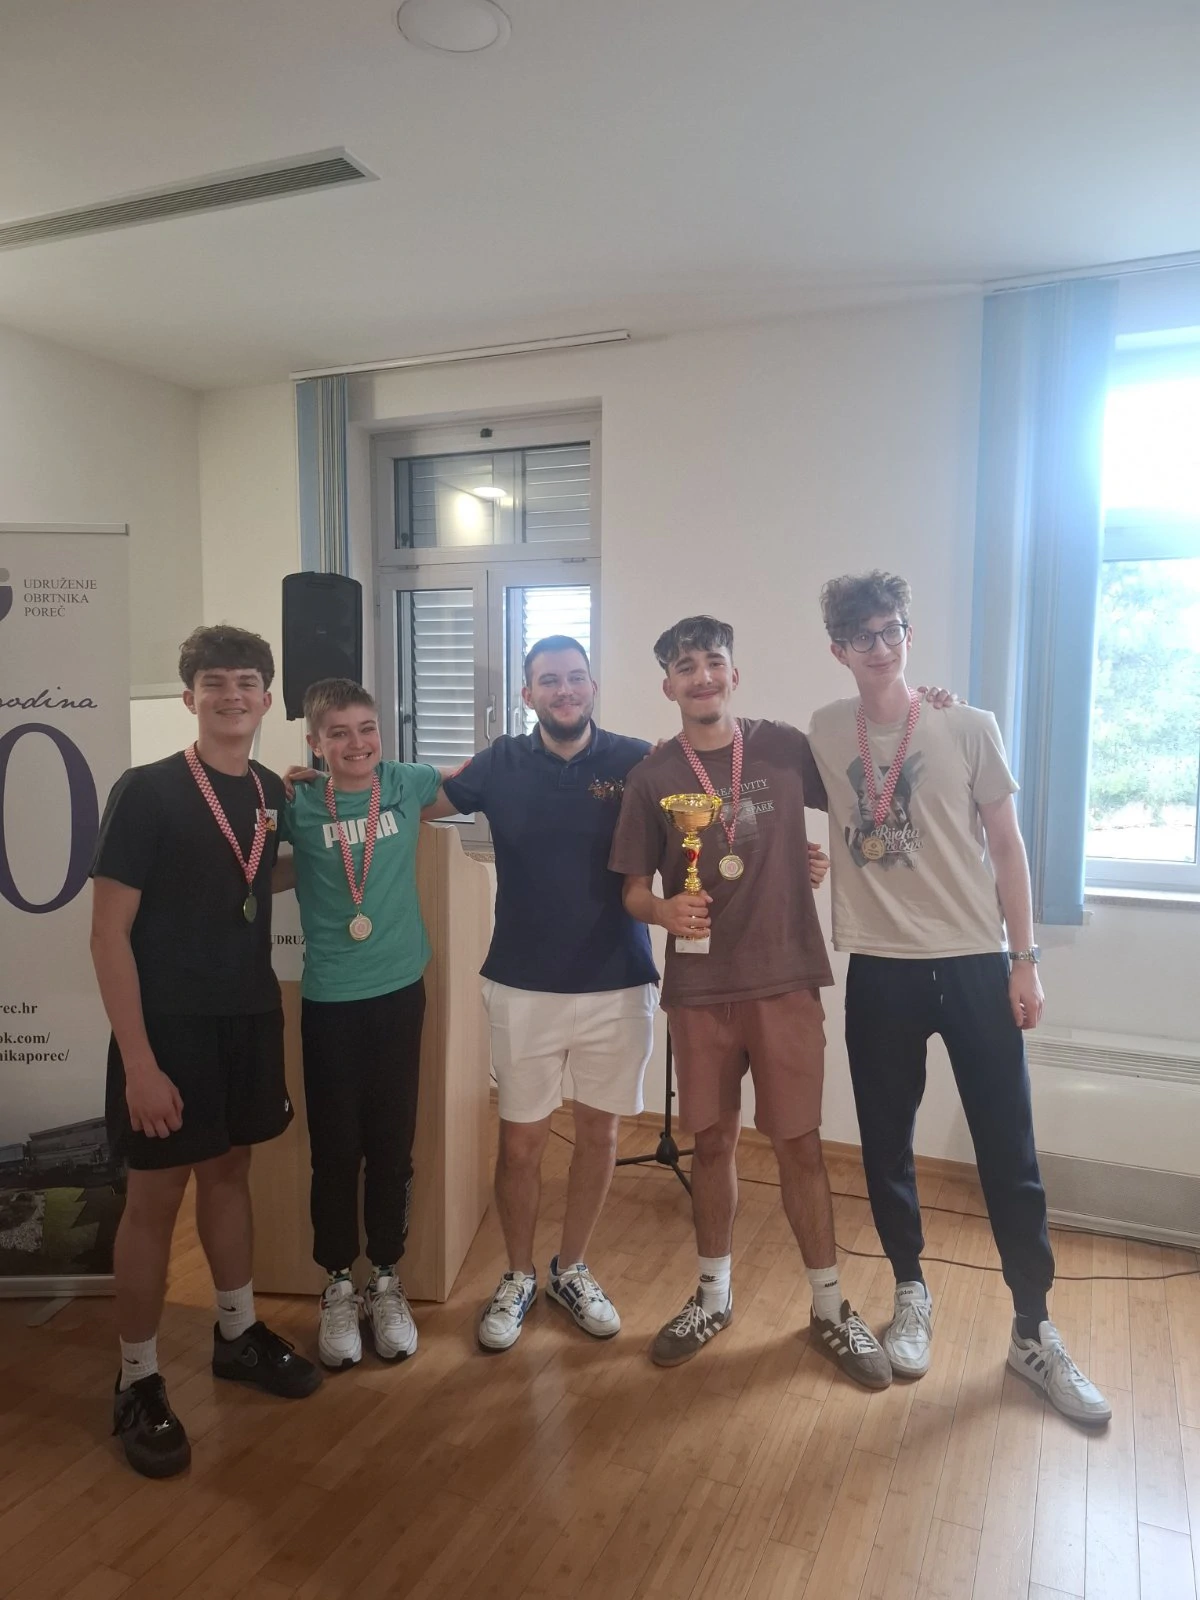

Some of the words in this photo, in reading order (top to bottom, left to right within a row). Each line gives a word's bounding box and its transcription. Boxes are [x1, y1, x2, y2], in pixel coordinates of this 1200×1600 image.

[23, 577, 97, 590] UDRUŽENJE
[23, 593, 89, 604] OBRTNIKA
[24, 605, 66, 617] POREČ
[0, 686, 97, 709] odina
[714, 778, 767, 797] REAIVITY
